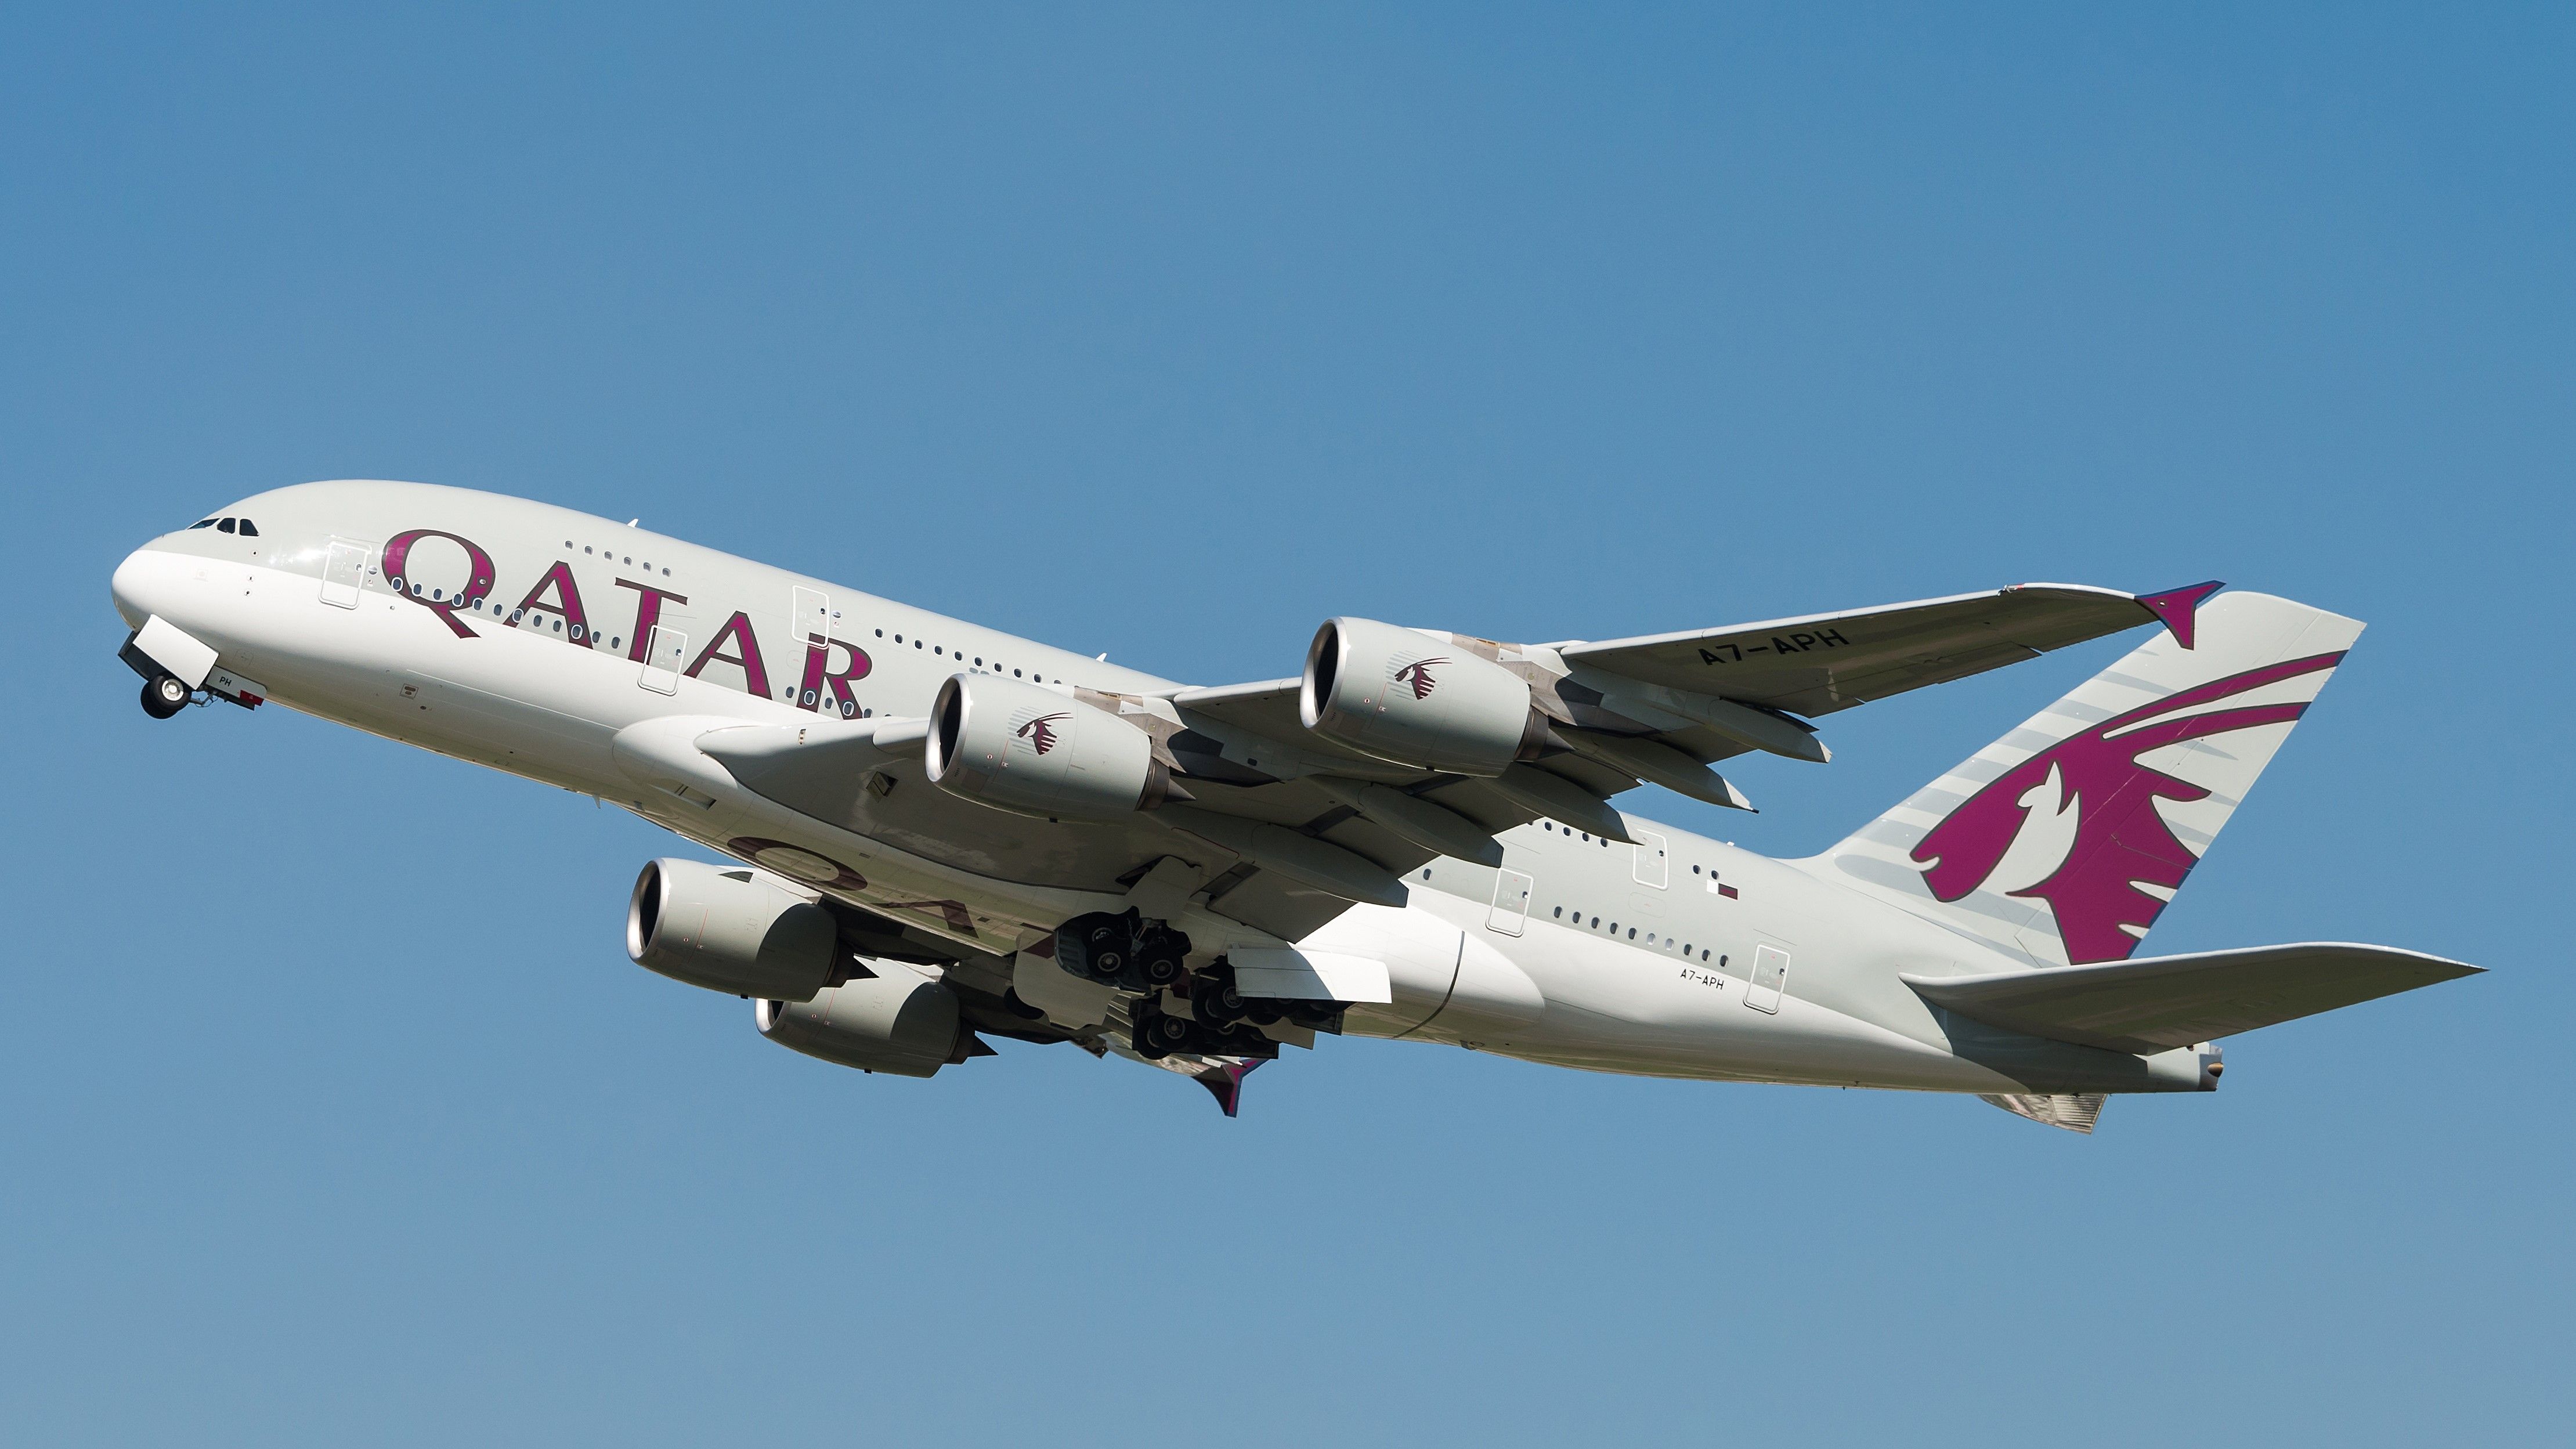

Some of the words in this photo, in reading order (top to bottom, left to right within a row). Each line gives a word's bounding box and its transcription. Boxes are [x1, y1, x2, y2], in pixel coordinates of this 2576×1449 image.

[381, 529, 872, 720] QATAR
[1698, 628, 1849, 665] A7-APH
[219, 676, 232, 687] PH
[1680, 969, 1724, 990] A7-APH
